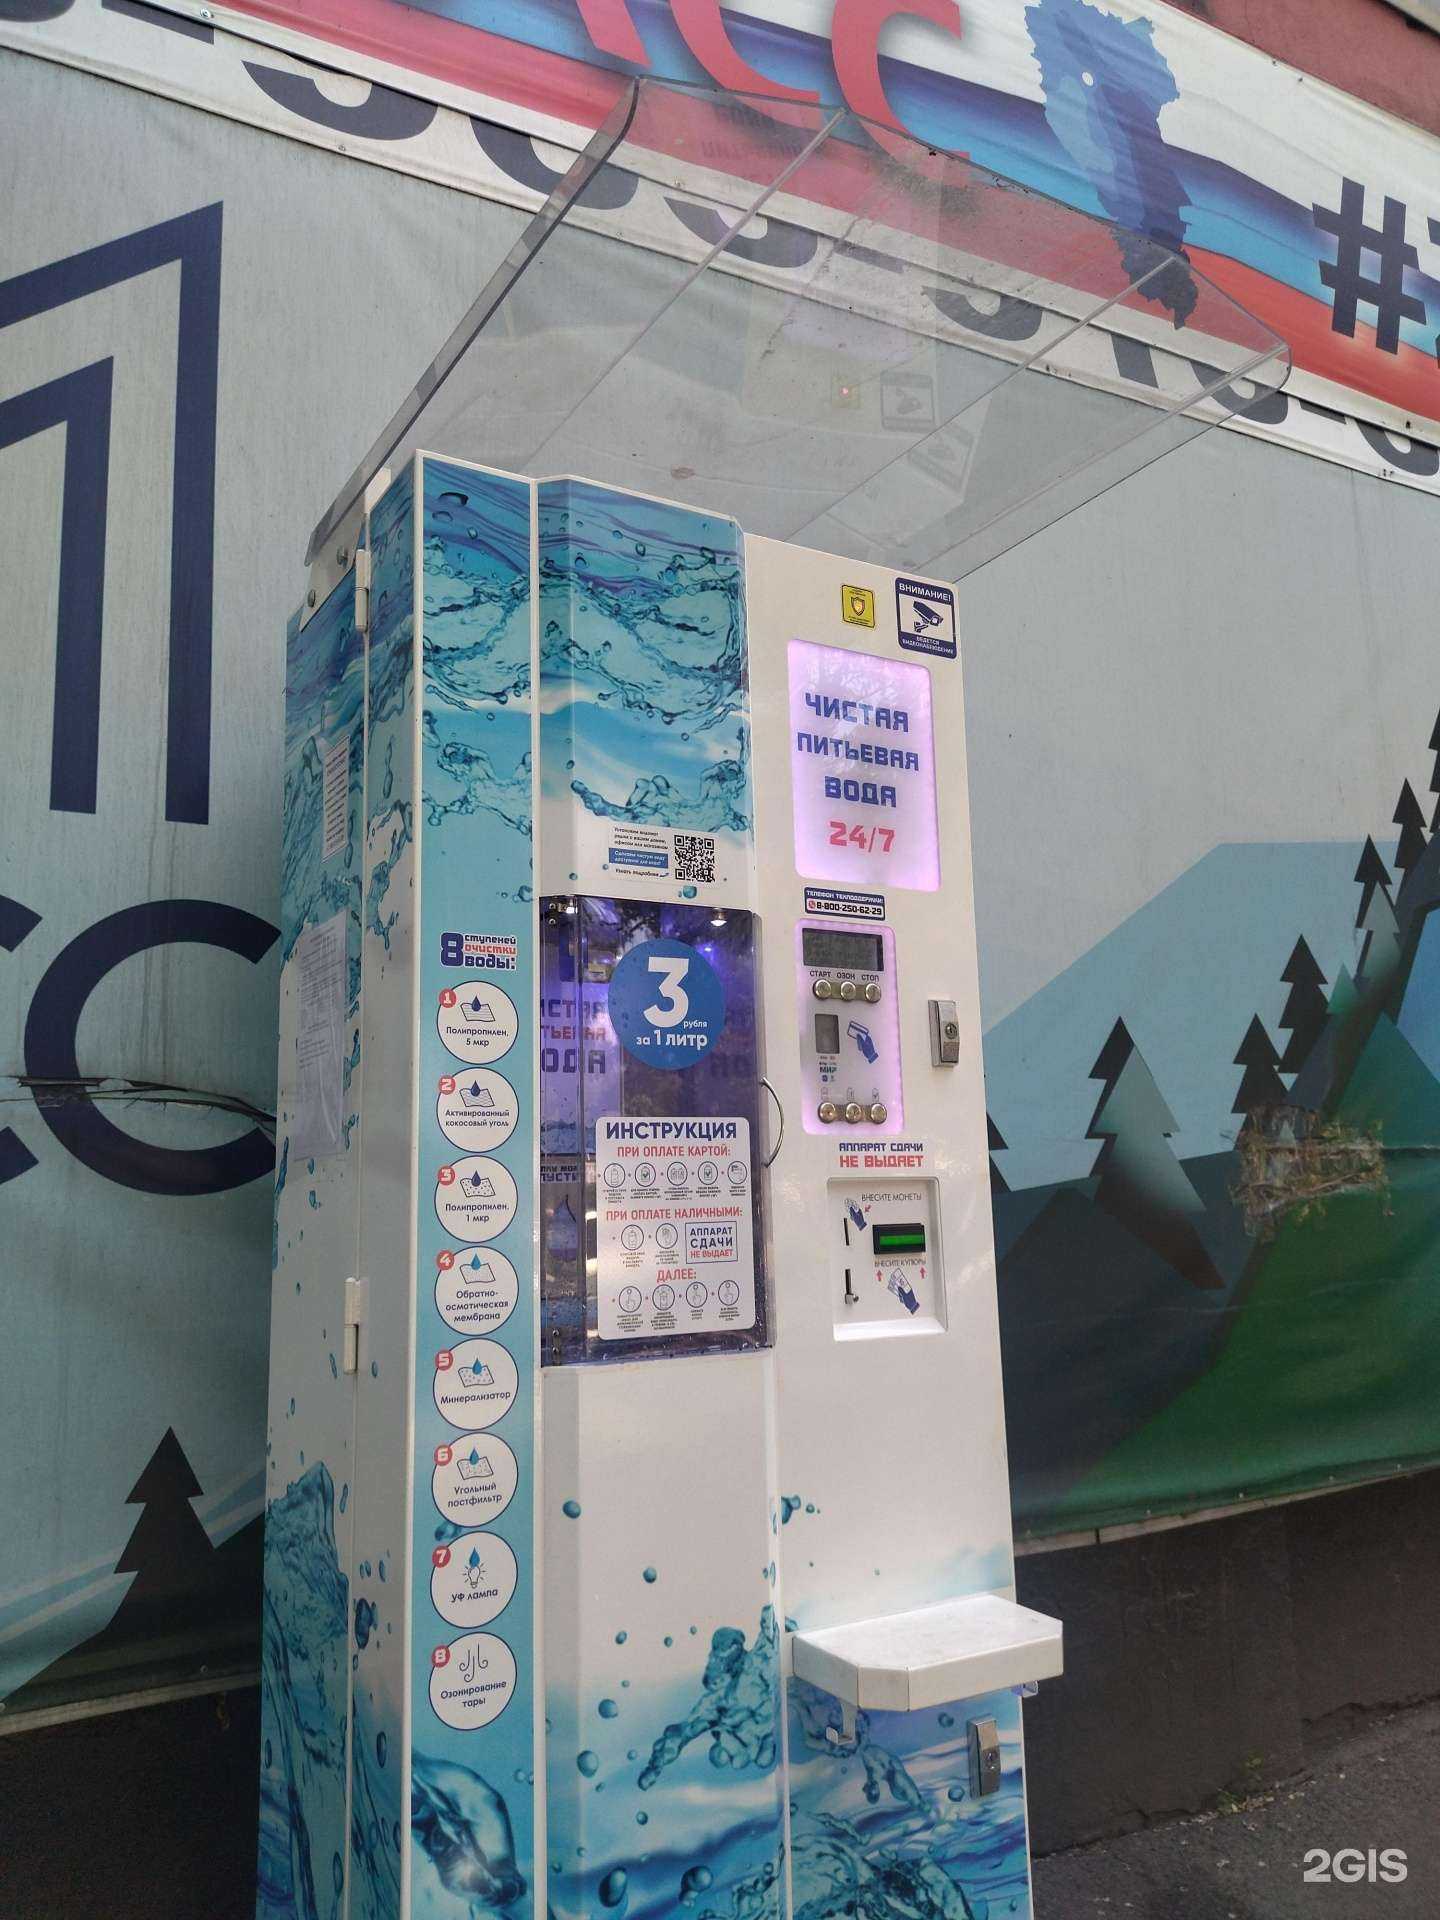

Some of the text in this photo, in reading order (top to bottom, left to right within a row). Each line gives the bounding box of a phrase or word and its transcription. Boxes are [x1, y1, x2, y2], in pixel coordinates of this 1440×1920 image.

[899, 583, 951, 602] ВНИМАНИЕ!
[805, 692, 910, 733] ЧИСТАЯ
[797, 732, 919, 772] ПИТЬЕВАЯ
[824, 775, 897, 808] ВОДА
[828, 820, 896, 853] 24/7
[807, 890, 834, 899] ТЕЛЕФОН
[816, 901, 882, 915] 8-800-250-62-29
[464, 934, 516, 945] ступеней
[441, 932, 464, 967] 8
[464, 944, 516, 955] очистки
[464, 954, 516, 969] воды:
[809, 970, 880, 982] СТАРТ ОЗОН СТОП
[444, 992, 451, 1004] 1
[643, 956, 690, 1028] 3
[683, 1019, 708, 1030] рубля
[466, 1038, 490, 1048] 5 мкр
[636, 1030, 708, 1050] за 1 литр
[441, 1079, 452, 1090] 2
[445, 1109, 509, 1118] Активированный
[445, 1119, 509, 1128] кокосовый уголь
[606, 1122, 737, 1140] ИНСТРУКЦИЯ
[617, 1143, 731, 1157] ПРИ ОПЛАТЕ КАРТОЙ:
[839, 1143, 923, 1152] АППАРАТ СДАЧИ
[839, 1155, 924, 1168] НЕ ВЫДАЕТ
[441, 1168, 451, 1181] 3
[861, 1193, 922, 1202] ВНЕСИТЕ МОНЕТЫ
[466, 1214, 490, 1224] 1 мкр
[606, 1206, 743, 1222] ПРИ ОПЛАТЕ НАЛИЧНЫМИ:
[690, 1226, 733, 1237] АППАРАТ
[690, 1237, 733, 1250] СДАЧИ
[690, 1250, 701, 1259] НЕ
[702, 1249, 733, 1259] ВЫДАЕТ
[440, 1255, 451, 1266] 4
[656, 1268, 697, 1282] ДАЛЕЕ:
[456, 1289, 499, 1300] Обратно-
[445, 1301, 509, 1312] осмотическая
[454, 1312, 501, 1322] мембрана
[439, 1354, 449, 1367] 5
[440, 1391, 511, 1404] Минерализатор
[439, 1449, 448, 1461] 6
[454, 1482, 497, 1495] Угольный
[447, 1494, 502, 1507] постфильтр
[437, 1551, 447, 1563] 7
[467, 1588, 498, 1601] лампа
[435, 1650, 446, 1662] 8
[440, 1680, 507, 1700] Озонирование
[462, 1697, 486, 1708] тары
